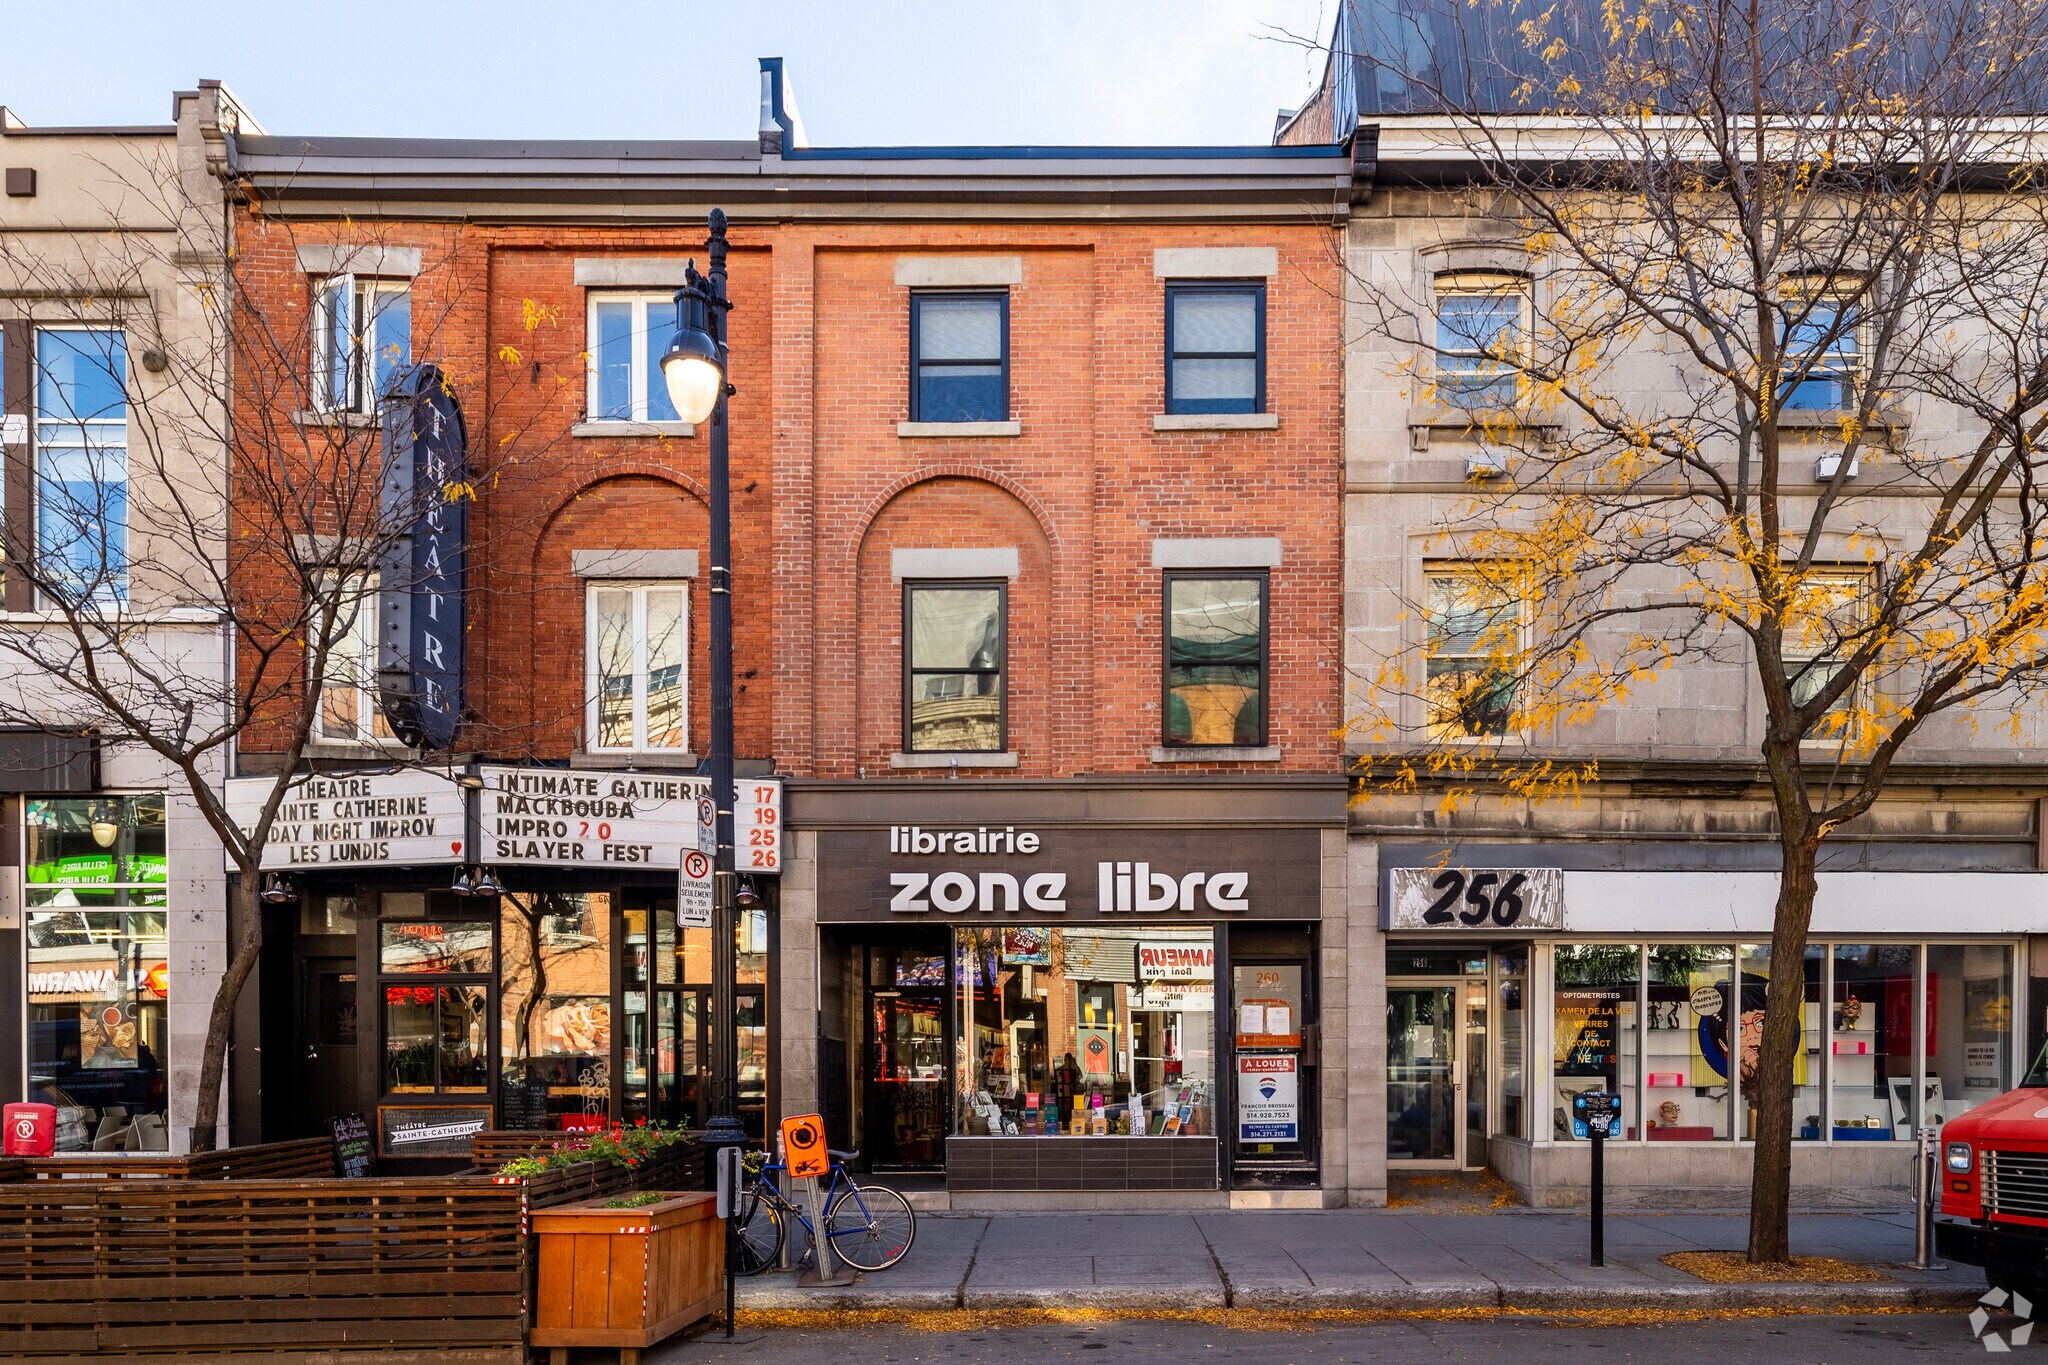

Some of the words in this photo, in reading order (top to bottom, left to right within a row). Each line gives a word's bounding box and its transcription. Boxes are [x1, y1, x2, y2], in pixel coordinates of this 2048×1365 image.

[298, 779, 371, 800] THEATRE
[499, 774, 598, 796] INTIMATE
[611, 780, 739, 802] GATHERINS
[754, 786, 775, 804] 17
[260, 803, 319, 821] AINTE
[333, 797, 427, 818] CATHERINE
[497, 796, 635, 818] MACKBOUBA
[754, 808, 776, 825] 19
[313, 821, 362, 841] NIGHT
[371, 818, 435, 838] IMPROV
[497, 818, 567, 838] IMPRO
[749, 829, 776, 846] 25
[890, 826, 1040, 853] librairie
[290, 845, 320, 863] LES
[330, 842, 389, 861] LUNDIS
[497, 841, 584, 860] SLAYER
[603, 844, 652, 862] FEST
[752, 850, 776, 867] 26
[681, 888, 712, 898] SEULEMENT
[682, 880, 711, 889] LIVRAISON
[890, 872, 1066, 912] zone
[1098, 862, 1248, 912] libre
[1423, 870, 1526, 926] 256
[1412, 957, 1428, 968] 256
[1256, 972, 1279, 984] 260
[1588, 1007, 1599, 1015] DE
[1602, 1007, 1614, 1015] LA
[1615, 1007, 1633, 1015] VUE
[1573, 1020, 1609, 1028] VERRES
[1584, 1030, 1597, 1038] DE
[1570, 1039, 1611, 1048] CONTACT
[396, 1122, 427, 1131] THÉÂTRE
[397, 1125, 479, 1140] SAINTE-CATHERINE
